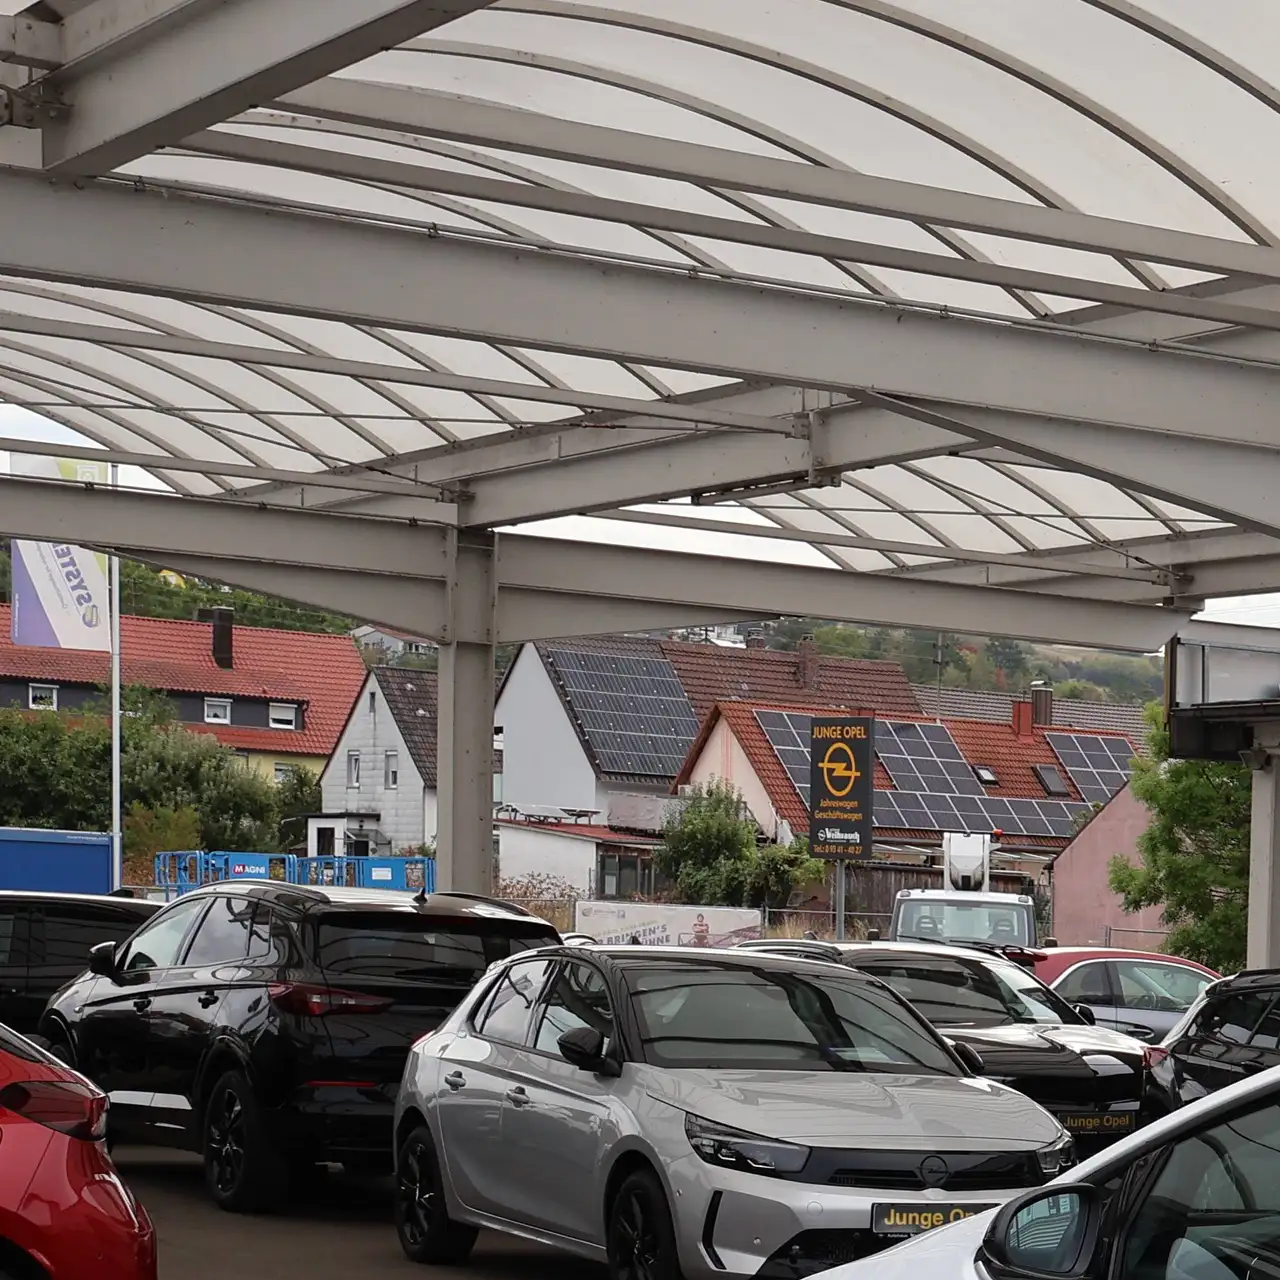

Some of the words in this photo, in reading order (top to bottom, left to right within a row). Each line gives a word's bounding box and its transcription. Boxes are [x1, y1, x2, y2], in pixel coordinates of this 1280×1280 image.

[813, 726, 842, 738] JUNGE
[844, 726, 867, 738] OPEL
[820, 799, 858, 809] Jahreswagen
[814, 810, 863, 821] Geschäftswagen
[1064, 1115, 1100, 1128] Junge
[1103, 1115, 1129, 1128] Opel
[884, 1209, 944, 1229] Junge
